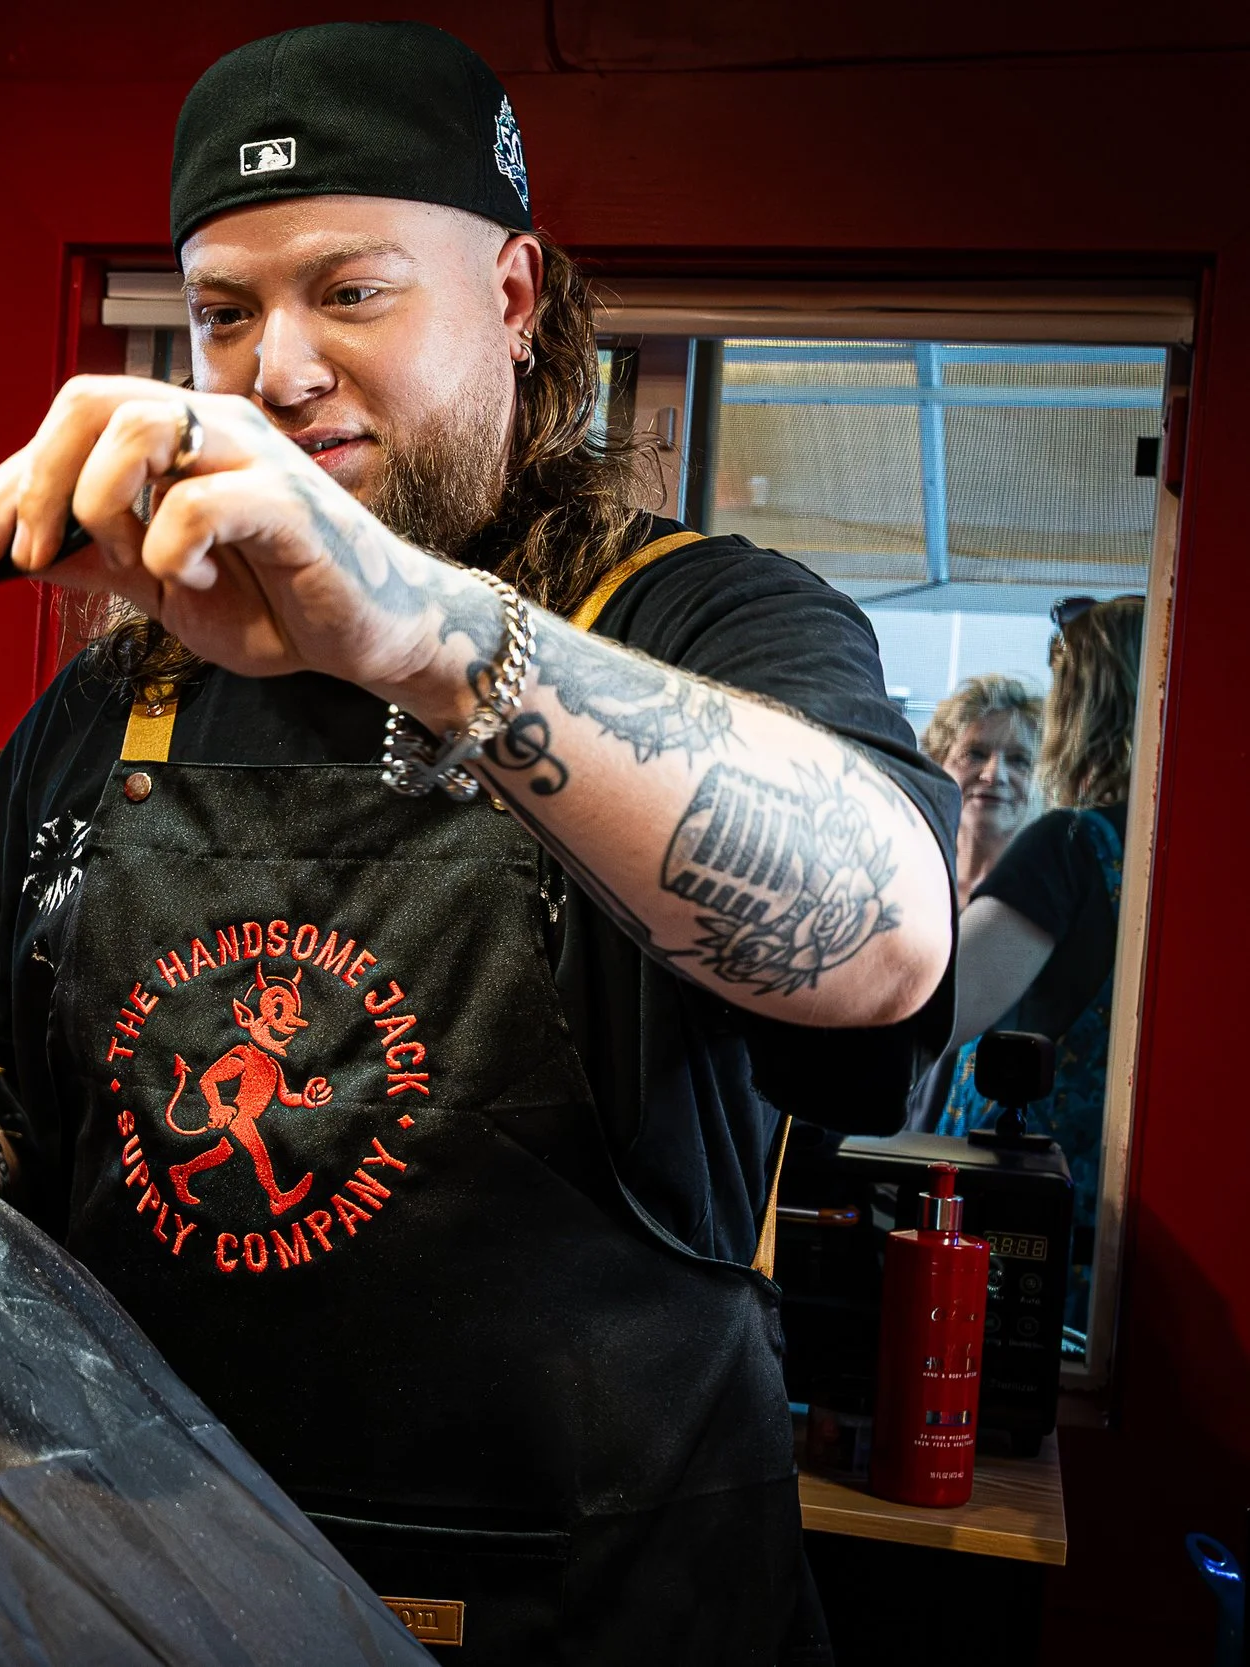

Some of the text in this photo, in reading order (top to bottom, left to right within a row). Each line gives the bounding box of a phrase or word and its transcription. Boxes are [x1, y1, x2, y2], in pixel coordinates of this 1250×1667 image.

[105, 920, 430, 1097] THE HANDSOME JACK
[116, 1110, 408, 1273] SUPPLY COMPANY
